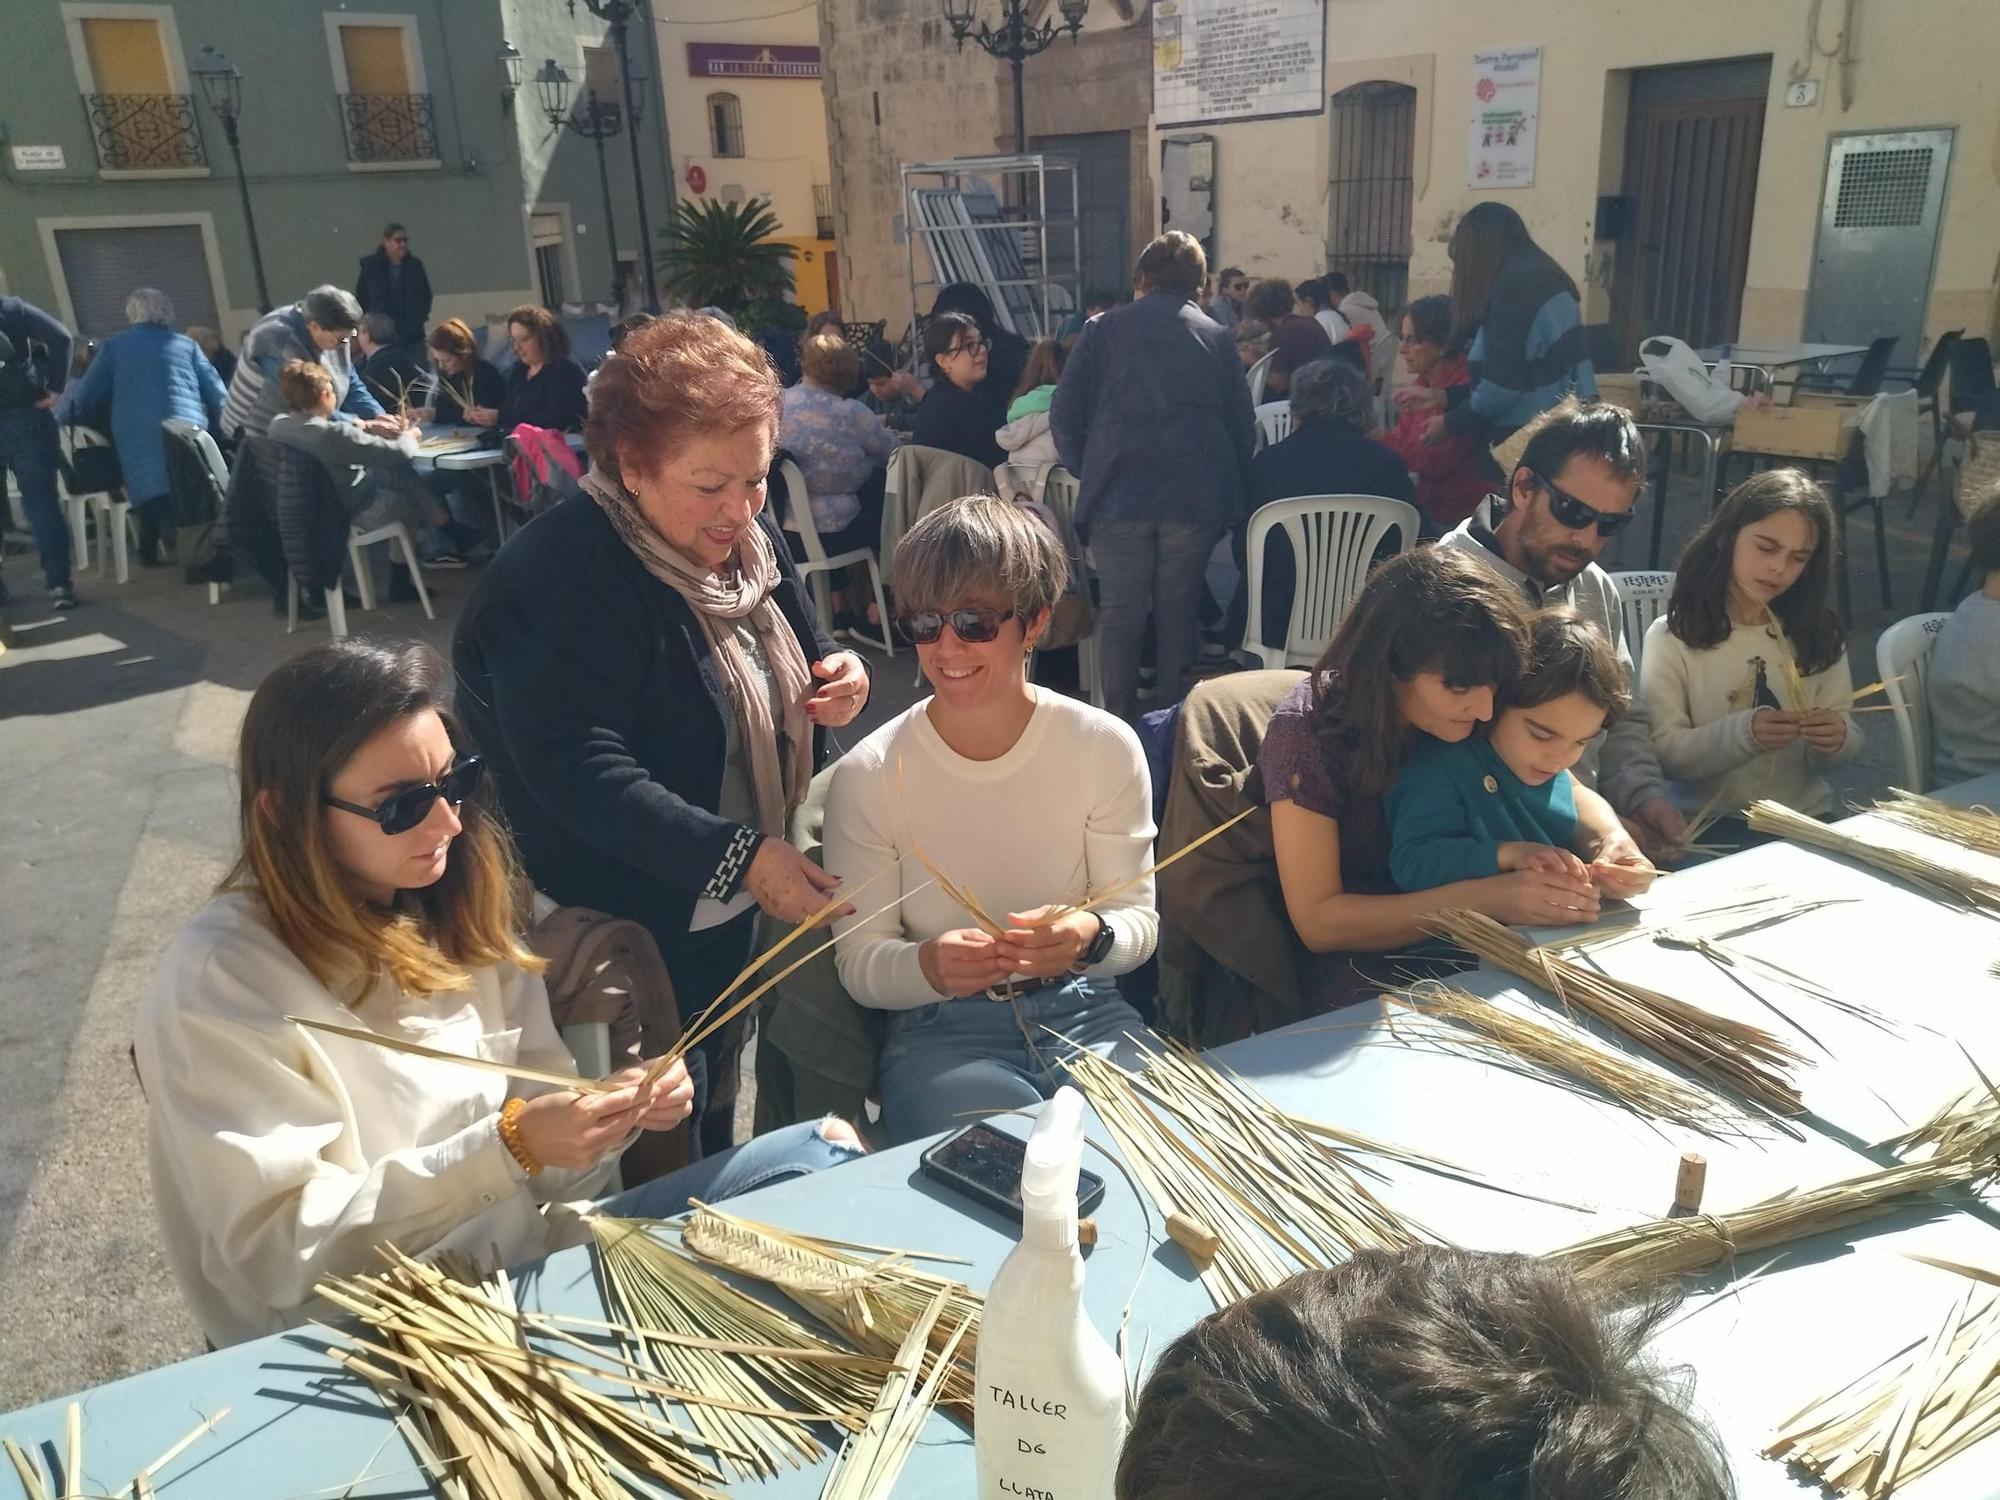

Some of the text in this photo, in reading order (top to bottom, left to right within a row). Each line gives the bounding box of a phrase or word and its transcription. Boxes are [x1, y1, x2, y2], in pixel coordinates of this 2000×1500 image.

[708, 62, 725, 73] BAR
[1796, 85, 1806, 104] 3
[1622, 574, 1669, 587] FESTERES
[989, 1385, 1067, 1420] TALLER
